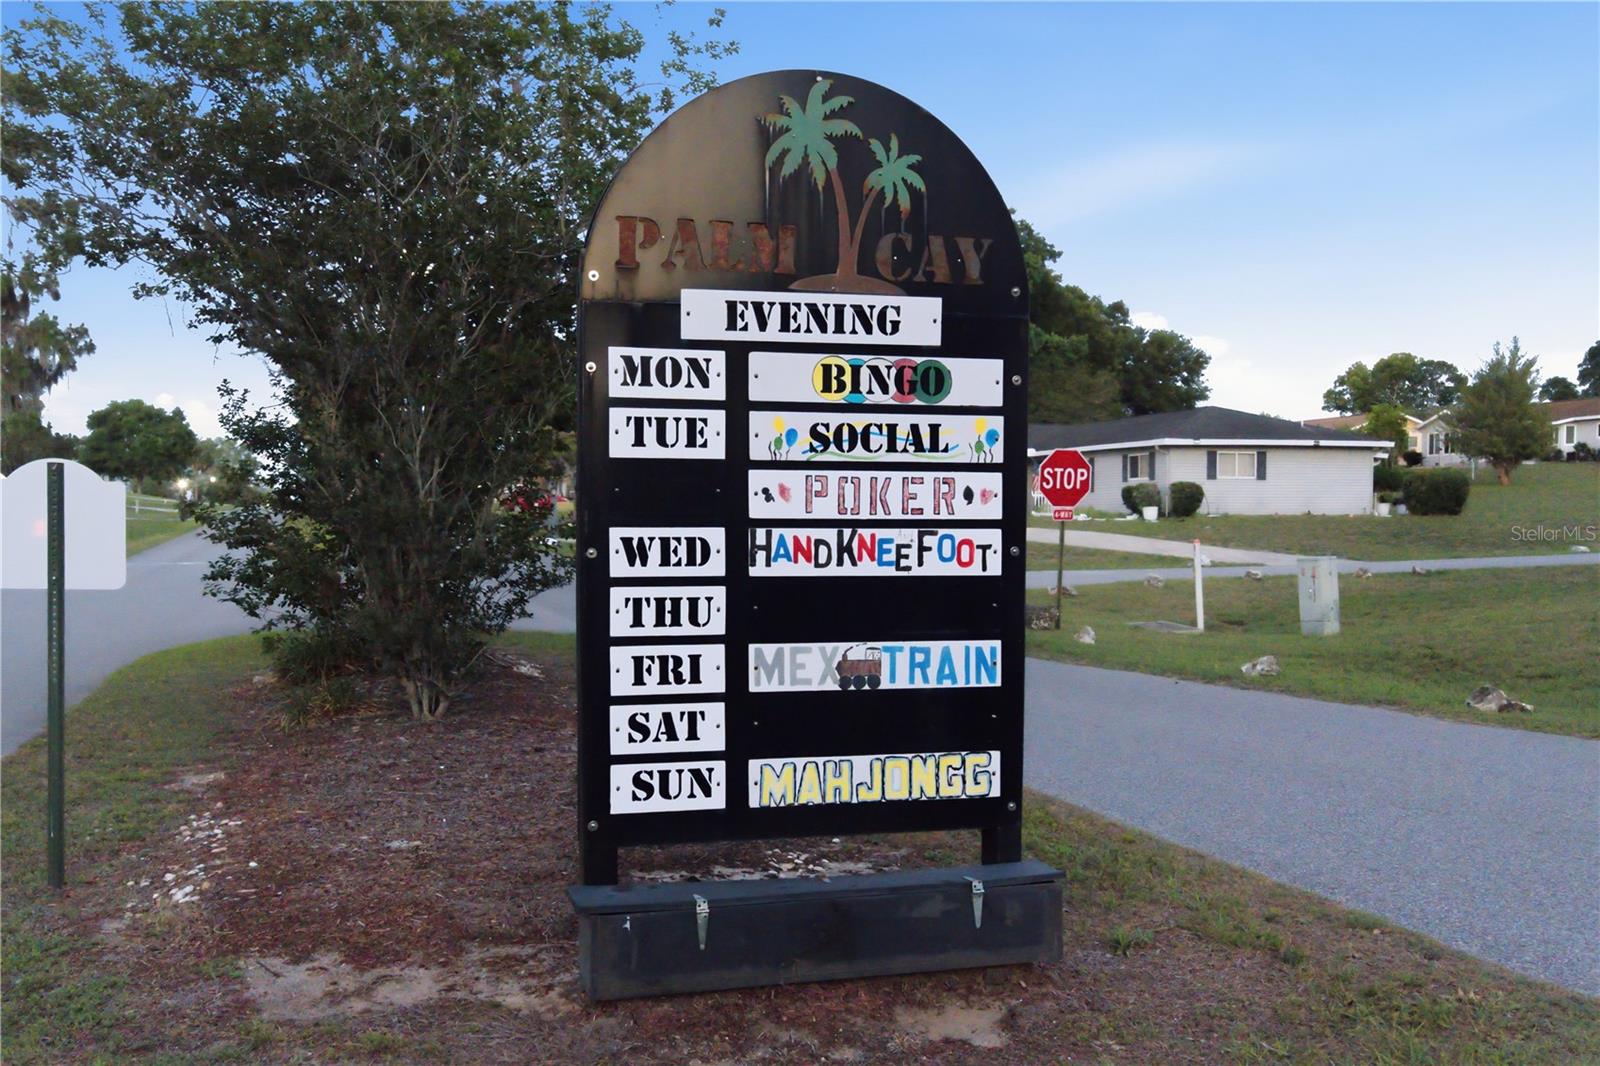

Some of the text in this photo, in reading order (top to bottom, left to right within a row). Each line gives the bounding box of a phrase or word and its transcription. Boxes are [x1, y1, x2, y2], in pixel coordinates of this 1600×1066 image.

[615, 215, 796, 274] PALM
[875, 232, 994, 285] CAY
[724, 299, 902, 336] EVENING
[619, 354, 712, 389] MON
[820, 363, 946, 398] BINGO
[626, 416, 709, 449] TUE
[808, 421, 950, 454] SOCIAL
[804, 475, 956, 516] POKER
[1042, 467, 1088, 490] STOP
[619, 536, 712, 568] WED
[624, 596, 715, 629] THU
[631, 654, 703, 687] FRI
[753, 645, 998, 688] MEX TRAIN
[627, 710, 706, 744] SAT
[631, 767, 715, 801] SUN
[759, 752, 992, 807] MAHJONGG
